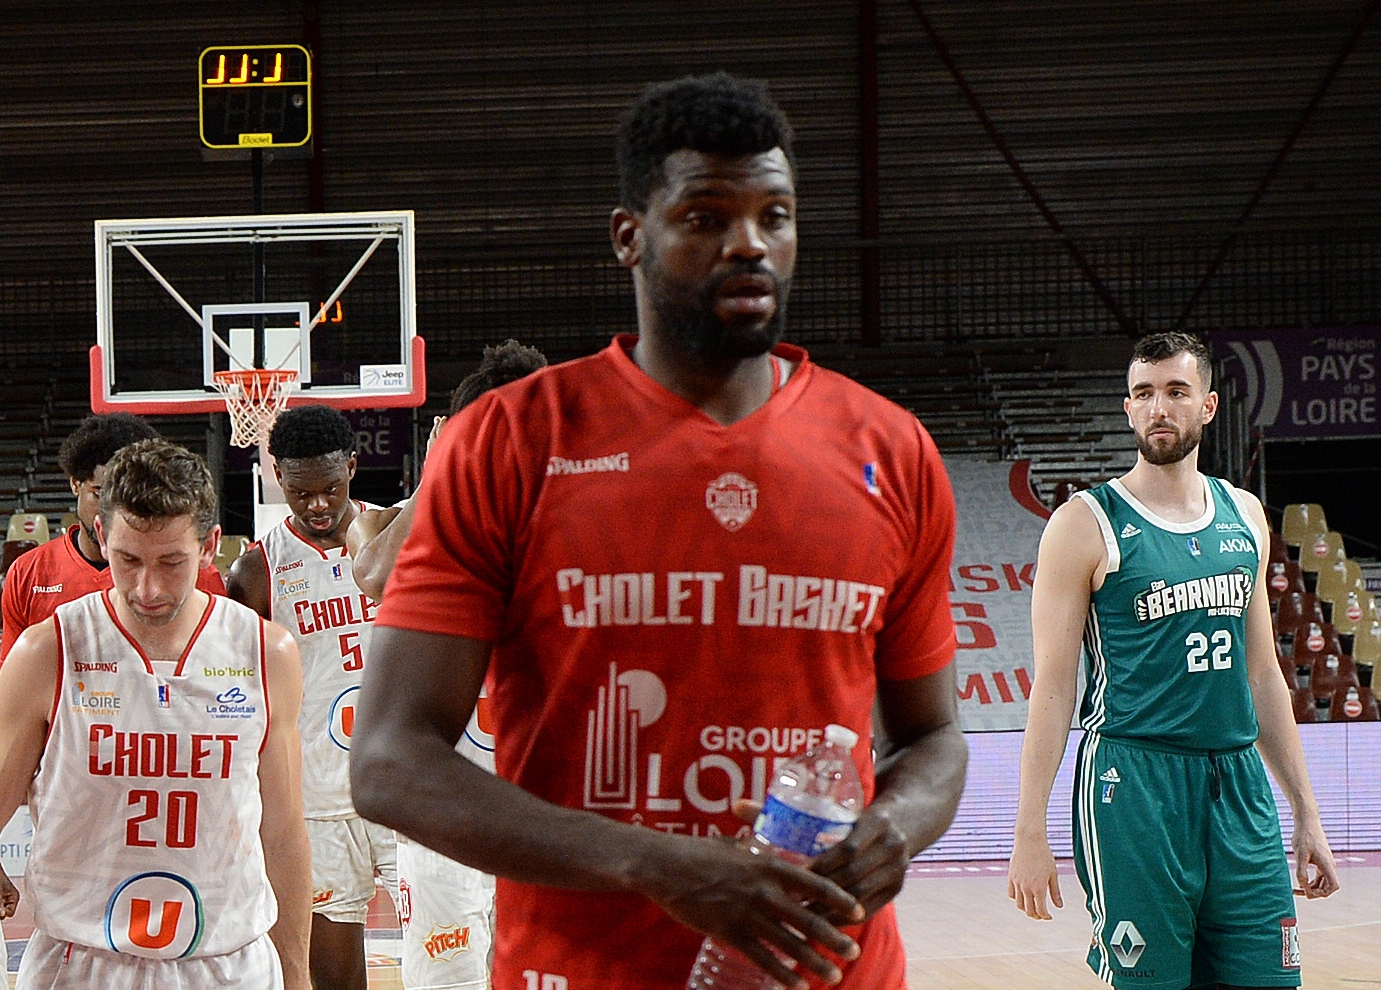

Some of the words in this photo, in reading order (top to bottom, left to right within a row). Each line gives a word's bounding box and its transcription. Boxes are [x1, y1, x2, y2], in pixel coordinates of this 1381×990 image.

[382, 370, 404, 380] Jeep
[1301, 353, 1376, 382] PAYS
[1344, 382, 1360, 394] de
[360, 416, 375, 427] de
[379, 415, 391, 427] la
[1292, 397, 1376, 426] LOIRE
[556, 567, 724, 628] CHOLET
[737, 564, 885, 634] BASKET
[1146, 574, 1244, 620] BEARNAIS
[294, 594, 382, 636] CHOLE
[338, 632, 364, 672] 5
[1185, 629, 1232, 673] 22
[74, 661, 118, 673] SPALDING
[204, 666, 255, 677] bio'bric
[81, 697, 121, 709] LOIRE
[206, 704, 218, 713] Le
[219, 704, 256, 714] Choletais
[88, 724, 239, 779] CHOLET
[125, 789, 199, 849] 20
[0, 843, 20, 858] PTI
